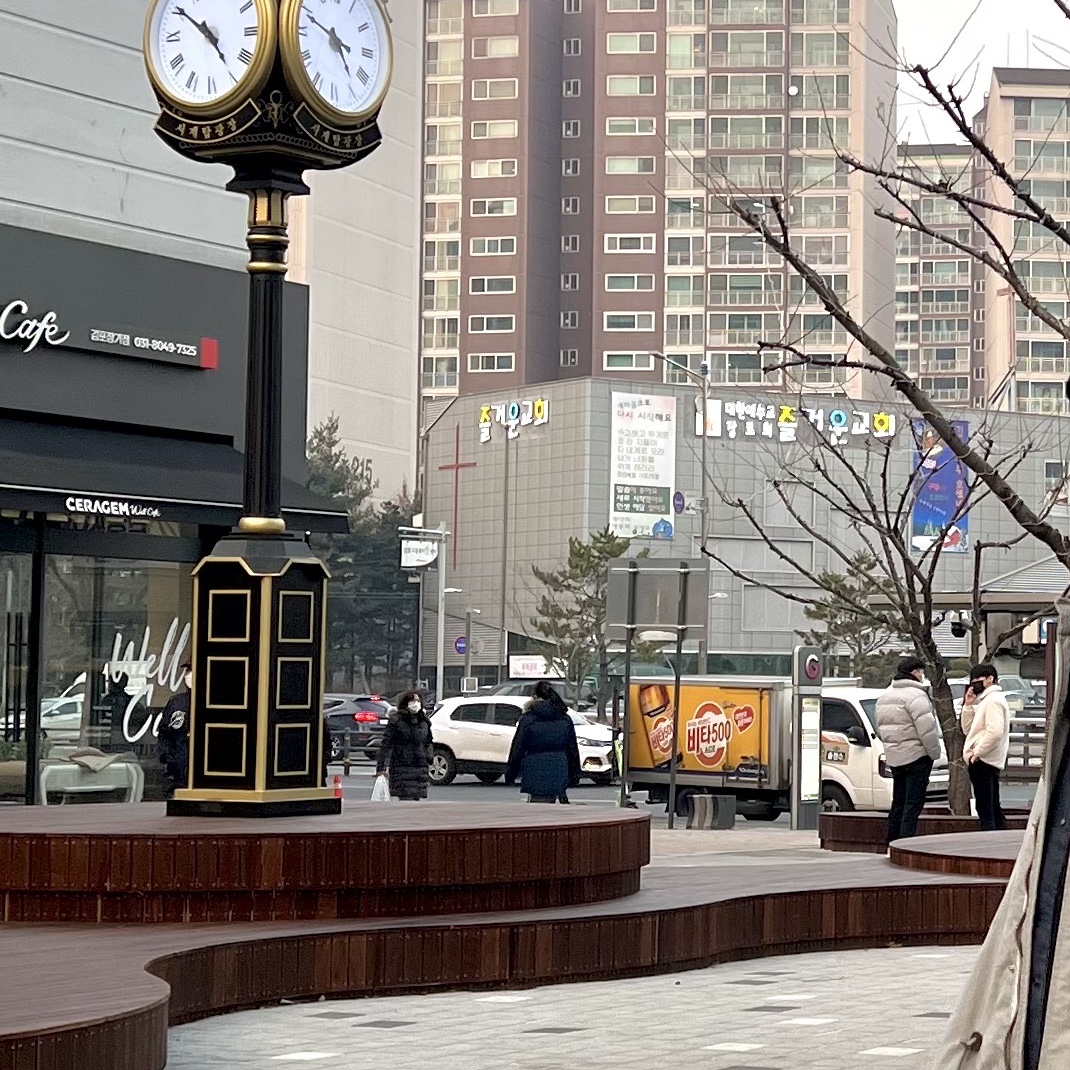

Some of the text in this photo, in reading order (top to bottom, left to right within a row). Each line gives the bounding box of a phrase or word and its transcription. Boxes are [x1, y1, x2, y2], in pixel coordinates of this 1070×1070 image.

[0, 300, 70, 353] Cafe
[479, 398, 549, 444] 즐거운교회
[777, 404, 896, 446] 즐거운교회
[66, 497, 130, 516] CERAGEM
[110, 617, 191, 692] Well
[688, 720, 731, 753] 비타500
